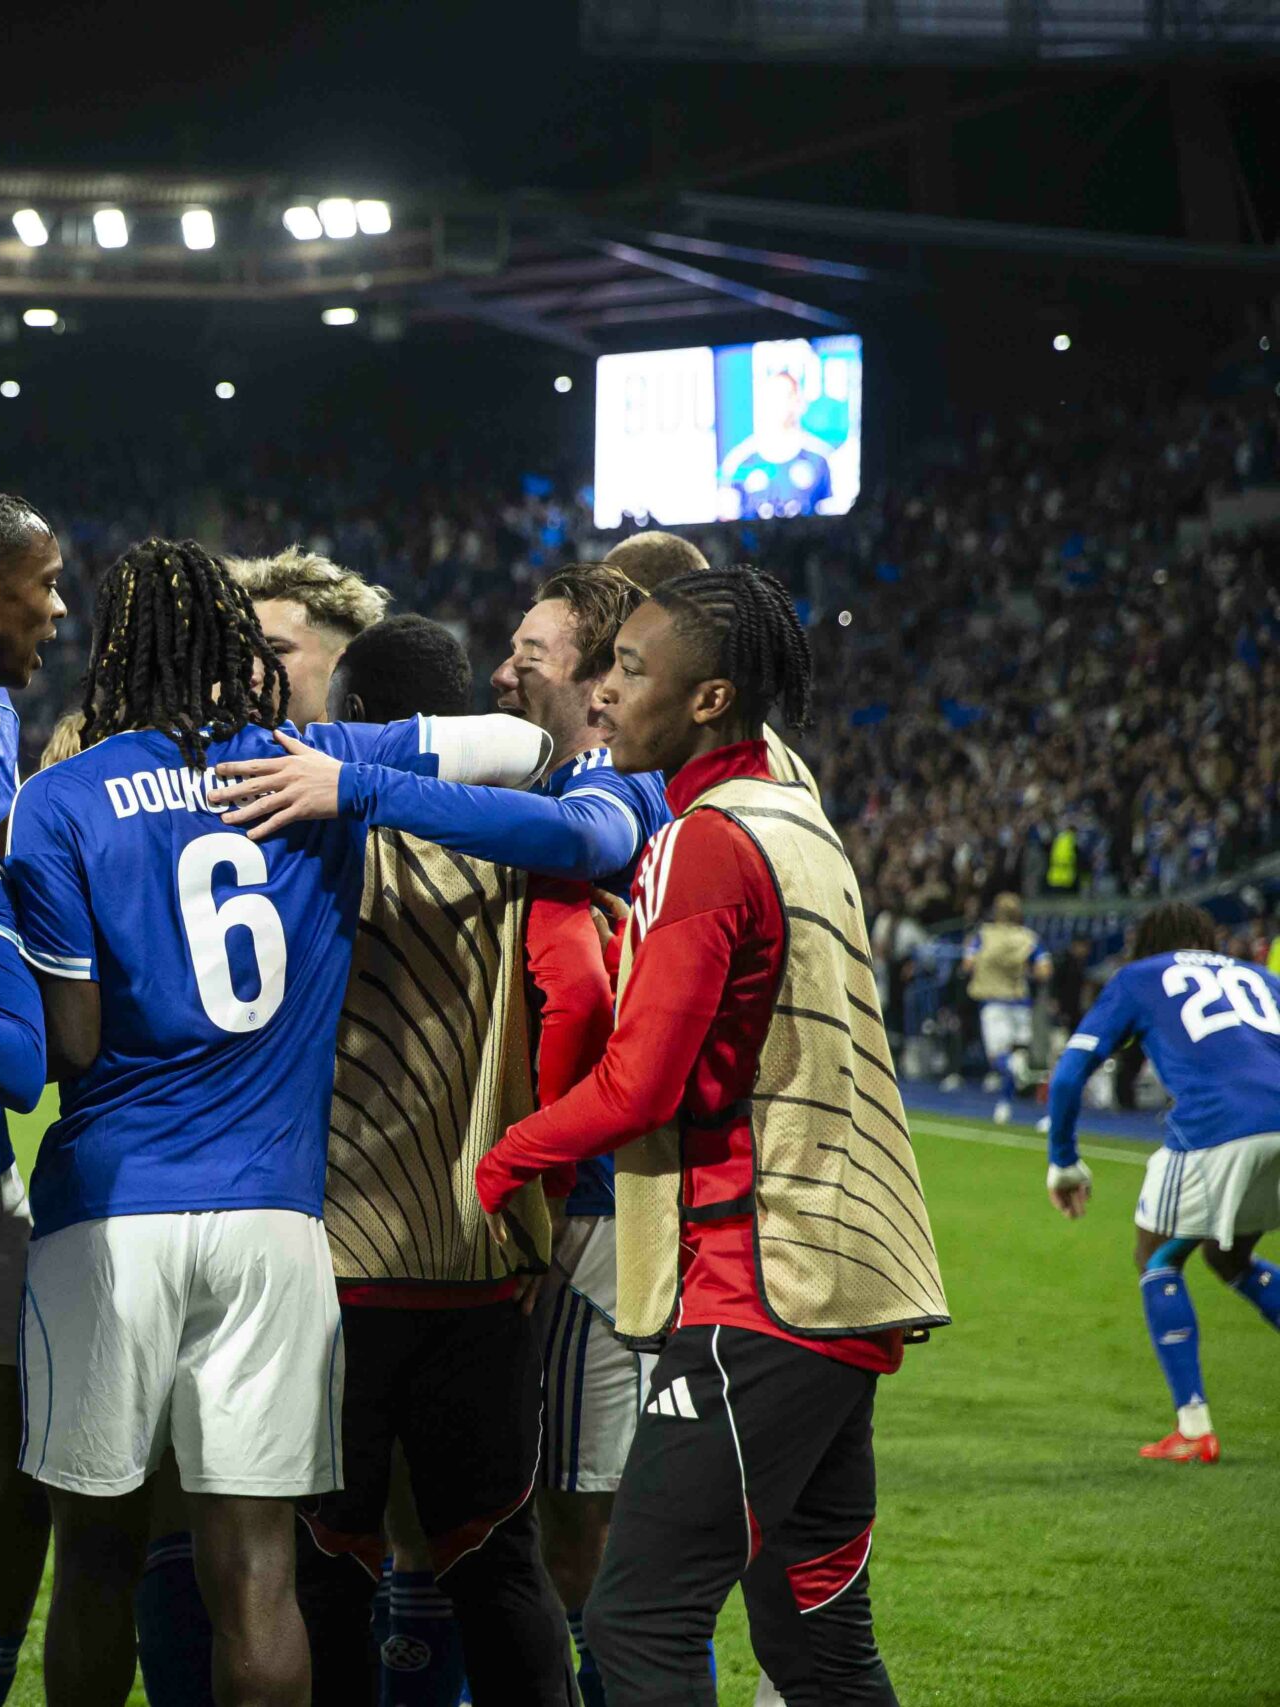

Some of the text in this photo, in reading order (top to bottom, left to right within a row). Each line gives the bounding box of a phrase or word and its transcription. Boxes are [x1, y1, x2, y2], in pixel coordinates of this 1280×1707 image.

[104, 766, 278, 819] DOUKO
[177, 832, 287, 1033] 6
[1161, 964, 1280, 1043] 20
